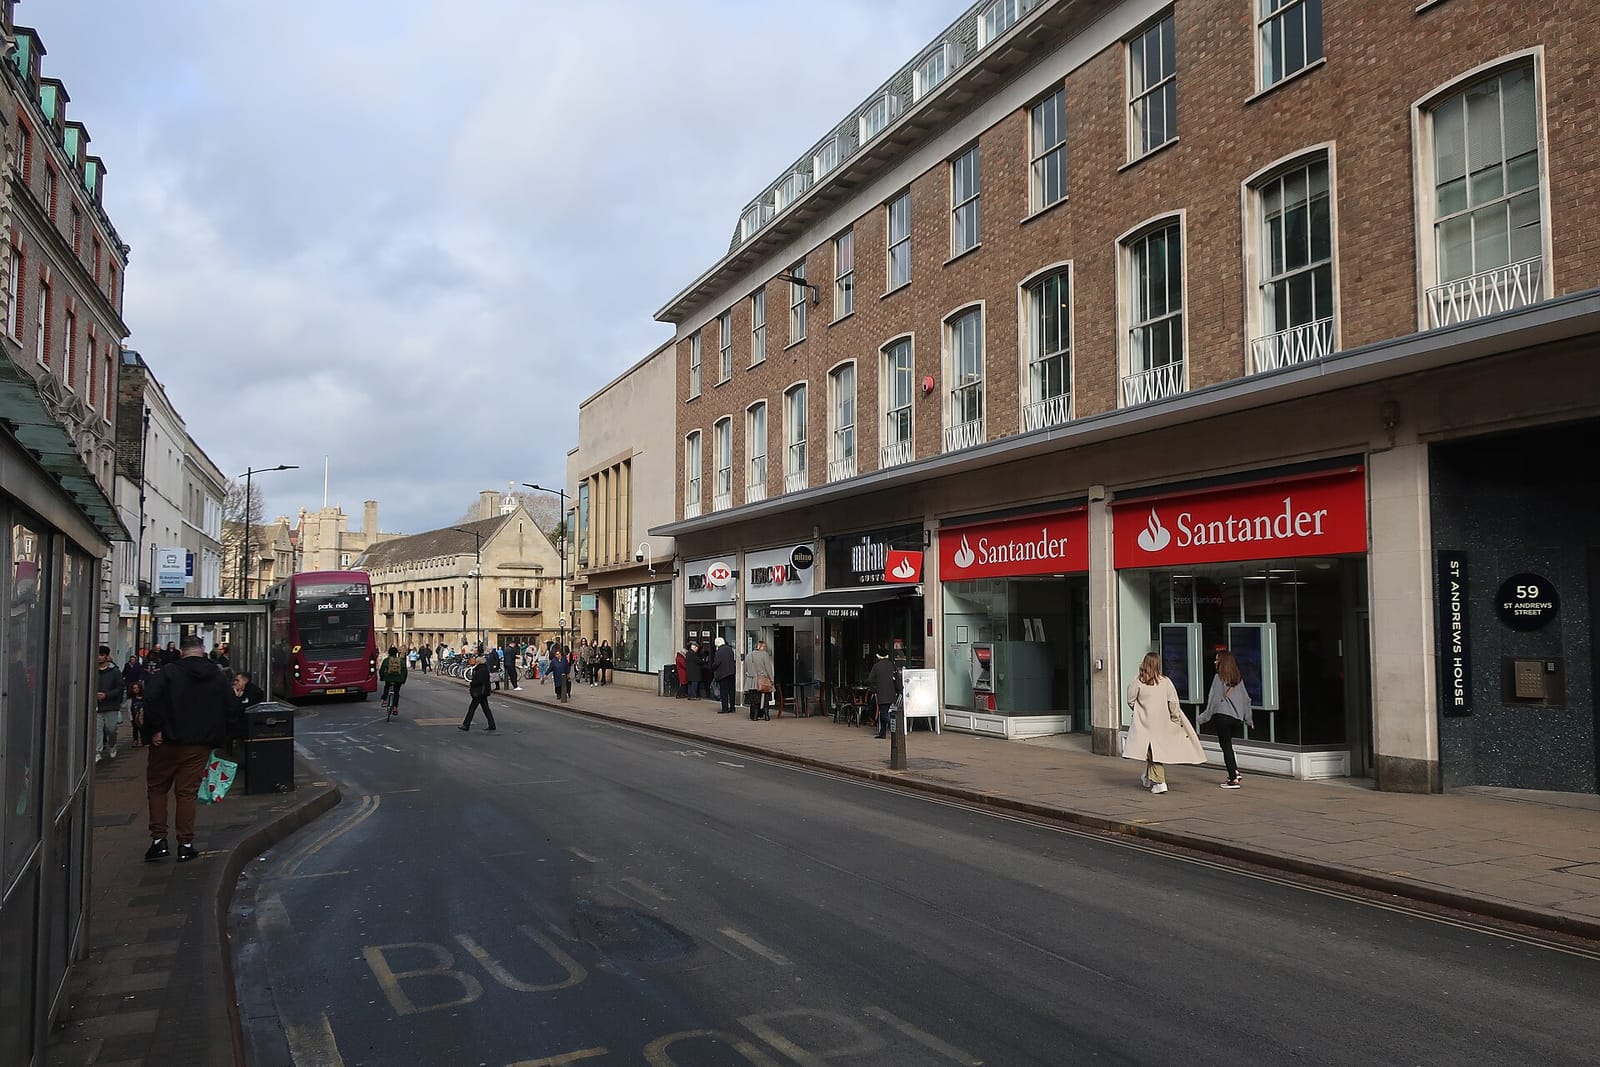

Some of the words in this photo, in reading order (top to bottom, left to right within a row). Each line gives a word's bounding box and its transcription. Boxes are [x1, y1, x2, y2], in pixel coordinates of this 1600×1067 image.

[1176, 497, 1328, 547] Santander
[978, 528, 1068, 566] Santander
[1450, 560, 1460, 577] ST
[318, 602, 333, 610] park
[335, 601, 349, 609] ride
[1516, 585, 1539, 599] 59
[1450, 581, 1462, 653] ANDREWS
[1453, 657, 1464, 706] HOUSE
